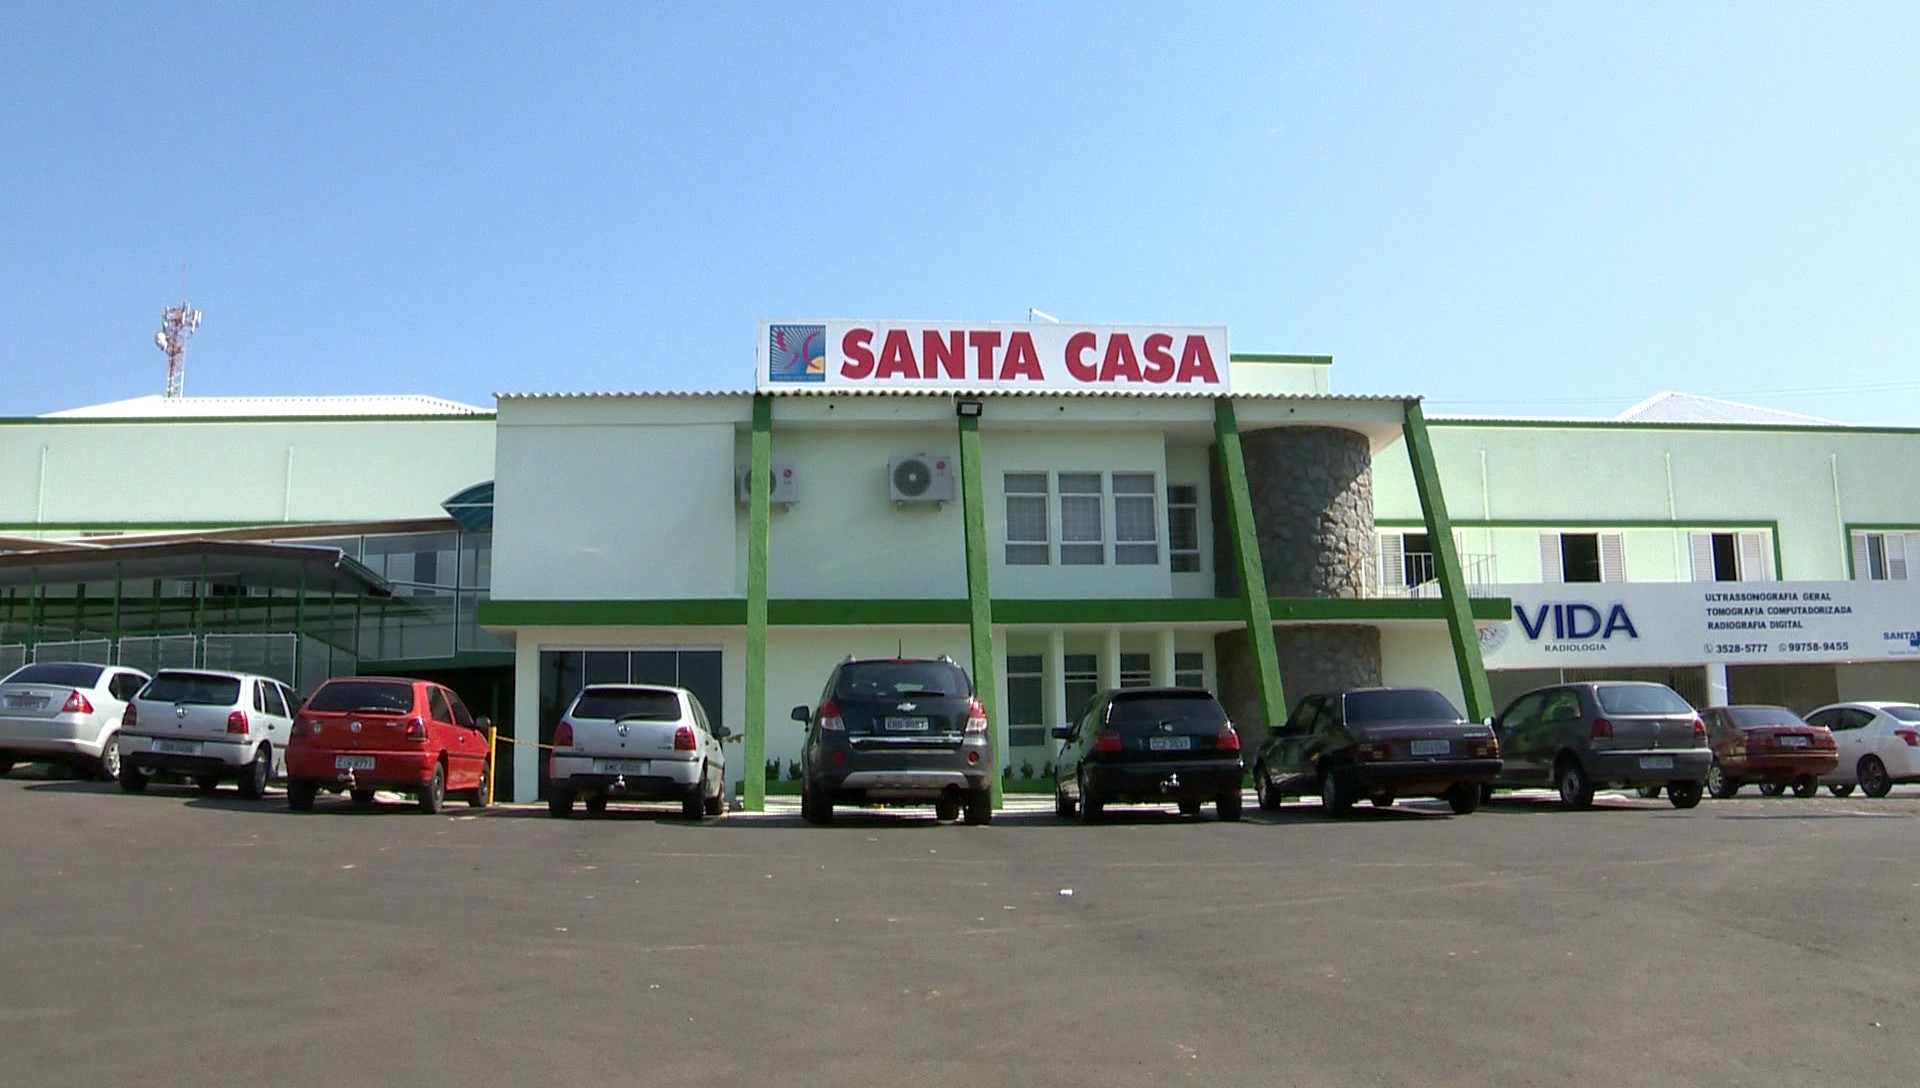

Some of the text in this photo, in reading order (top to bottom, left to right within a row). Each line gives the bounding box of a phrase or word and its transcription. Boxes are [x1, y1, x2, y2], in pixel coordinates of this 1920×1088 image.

[840, 328, 1220, 384] SANTA CASA
[1705, 592, 1831, 602] ULTRASSONOGRAFIA GERAL
[1706, 605, 1853, 616] TOMOGRAFIA COMPUTADORIZADA
[1513, 603, 1639, 640] VIDA
[1707, 619, 1803, 630] RADIOGRAFIA DIGITAL
[1883, 631, 1917, 640] SANTA
[1544, 643, 1607, 652] RADIOLOGIA
[1716, 641, 1849, 653] 3528-5777 99758-9455
